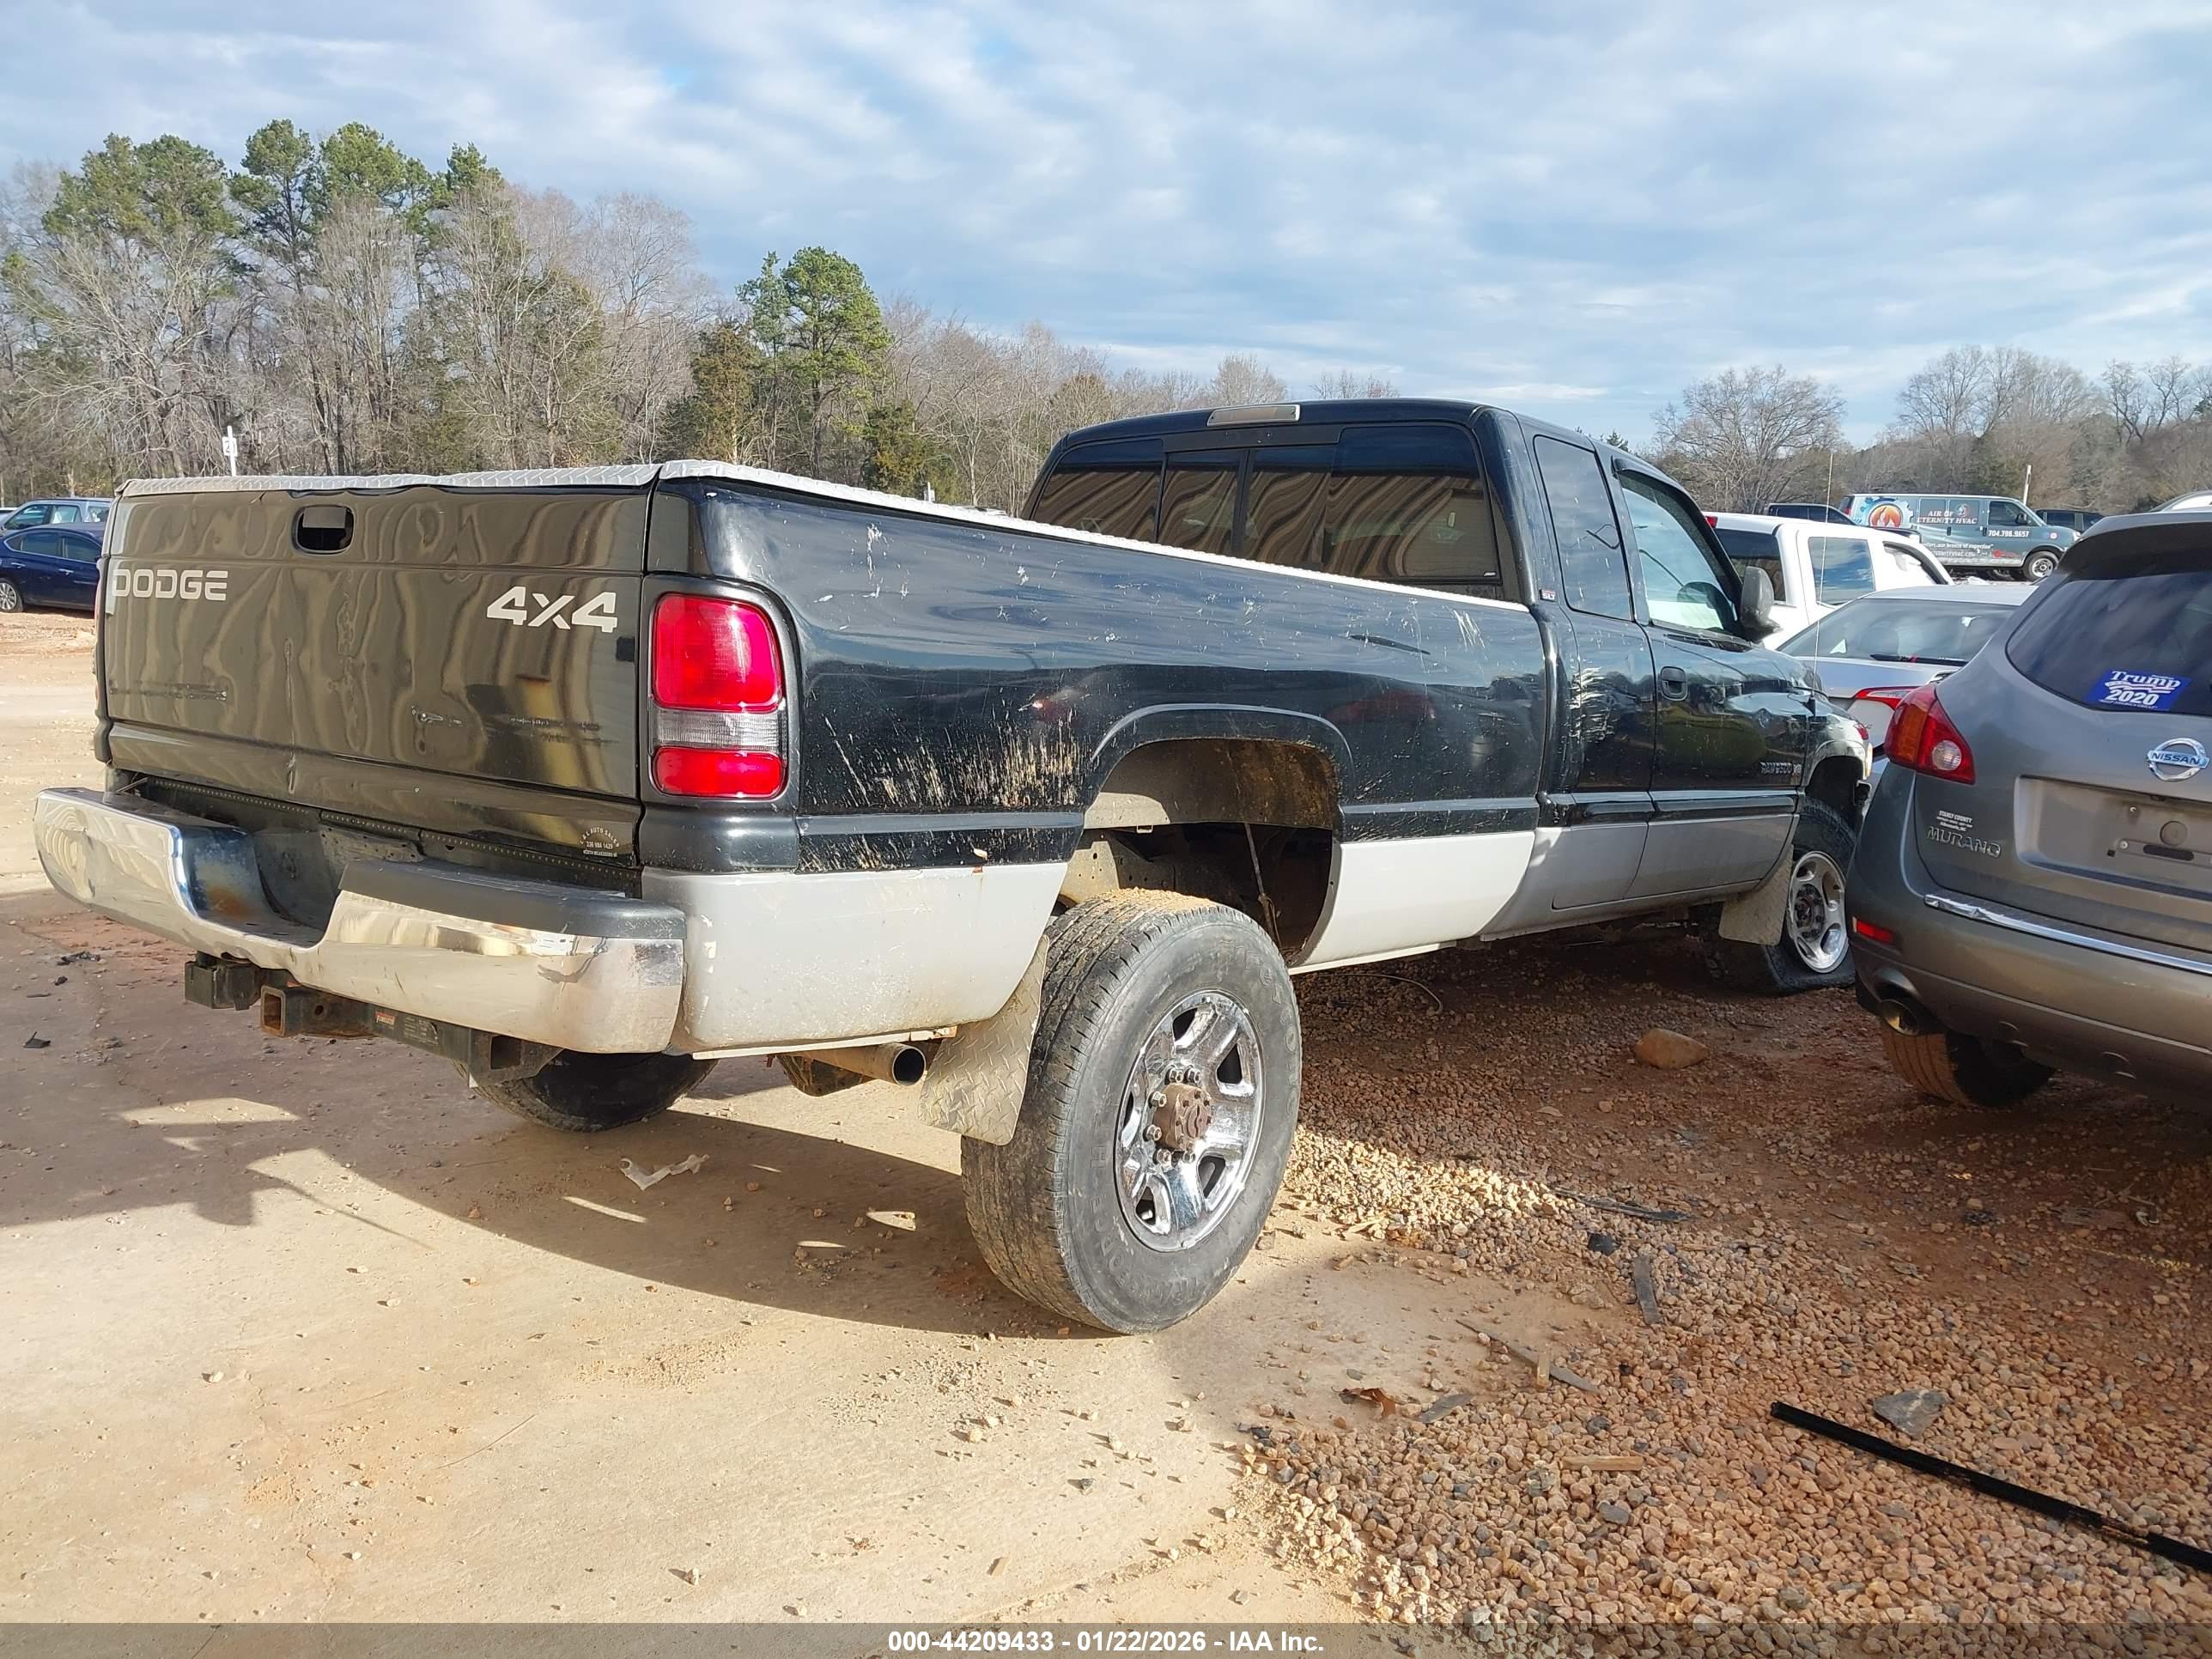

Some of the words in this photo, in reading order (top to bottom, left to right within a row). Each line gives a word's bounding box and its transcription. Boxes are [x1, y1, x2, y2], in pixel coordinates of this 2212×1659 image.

[112, 568, 228, 601] DODGE
[2111, 671, 2181, 688] Trump
[2105, 690, 2160, 706] 2020
[2152, 752, 2199, 765] NISSAN
[605, 830, 620, 848] SALES
[1927, 826, 2002, 858] MURANO
